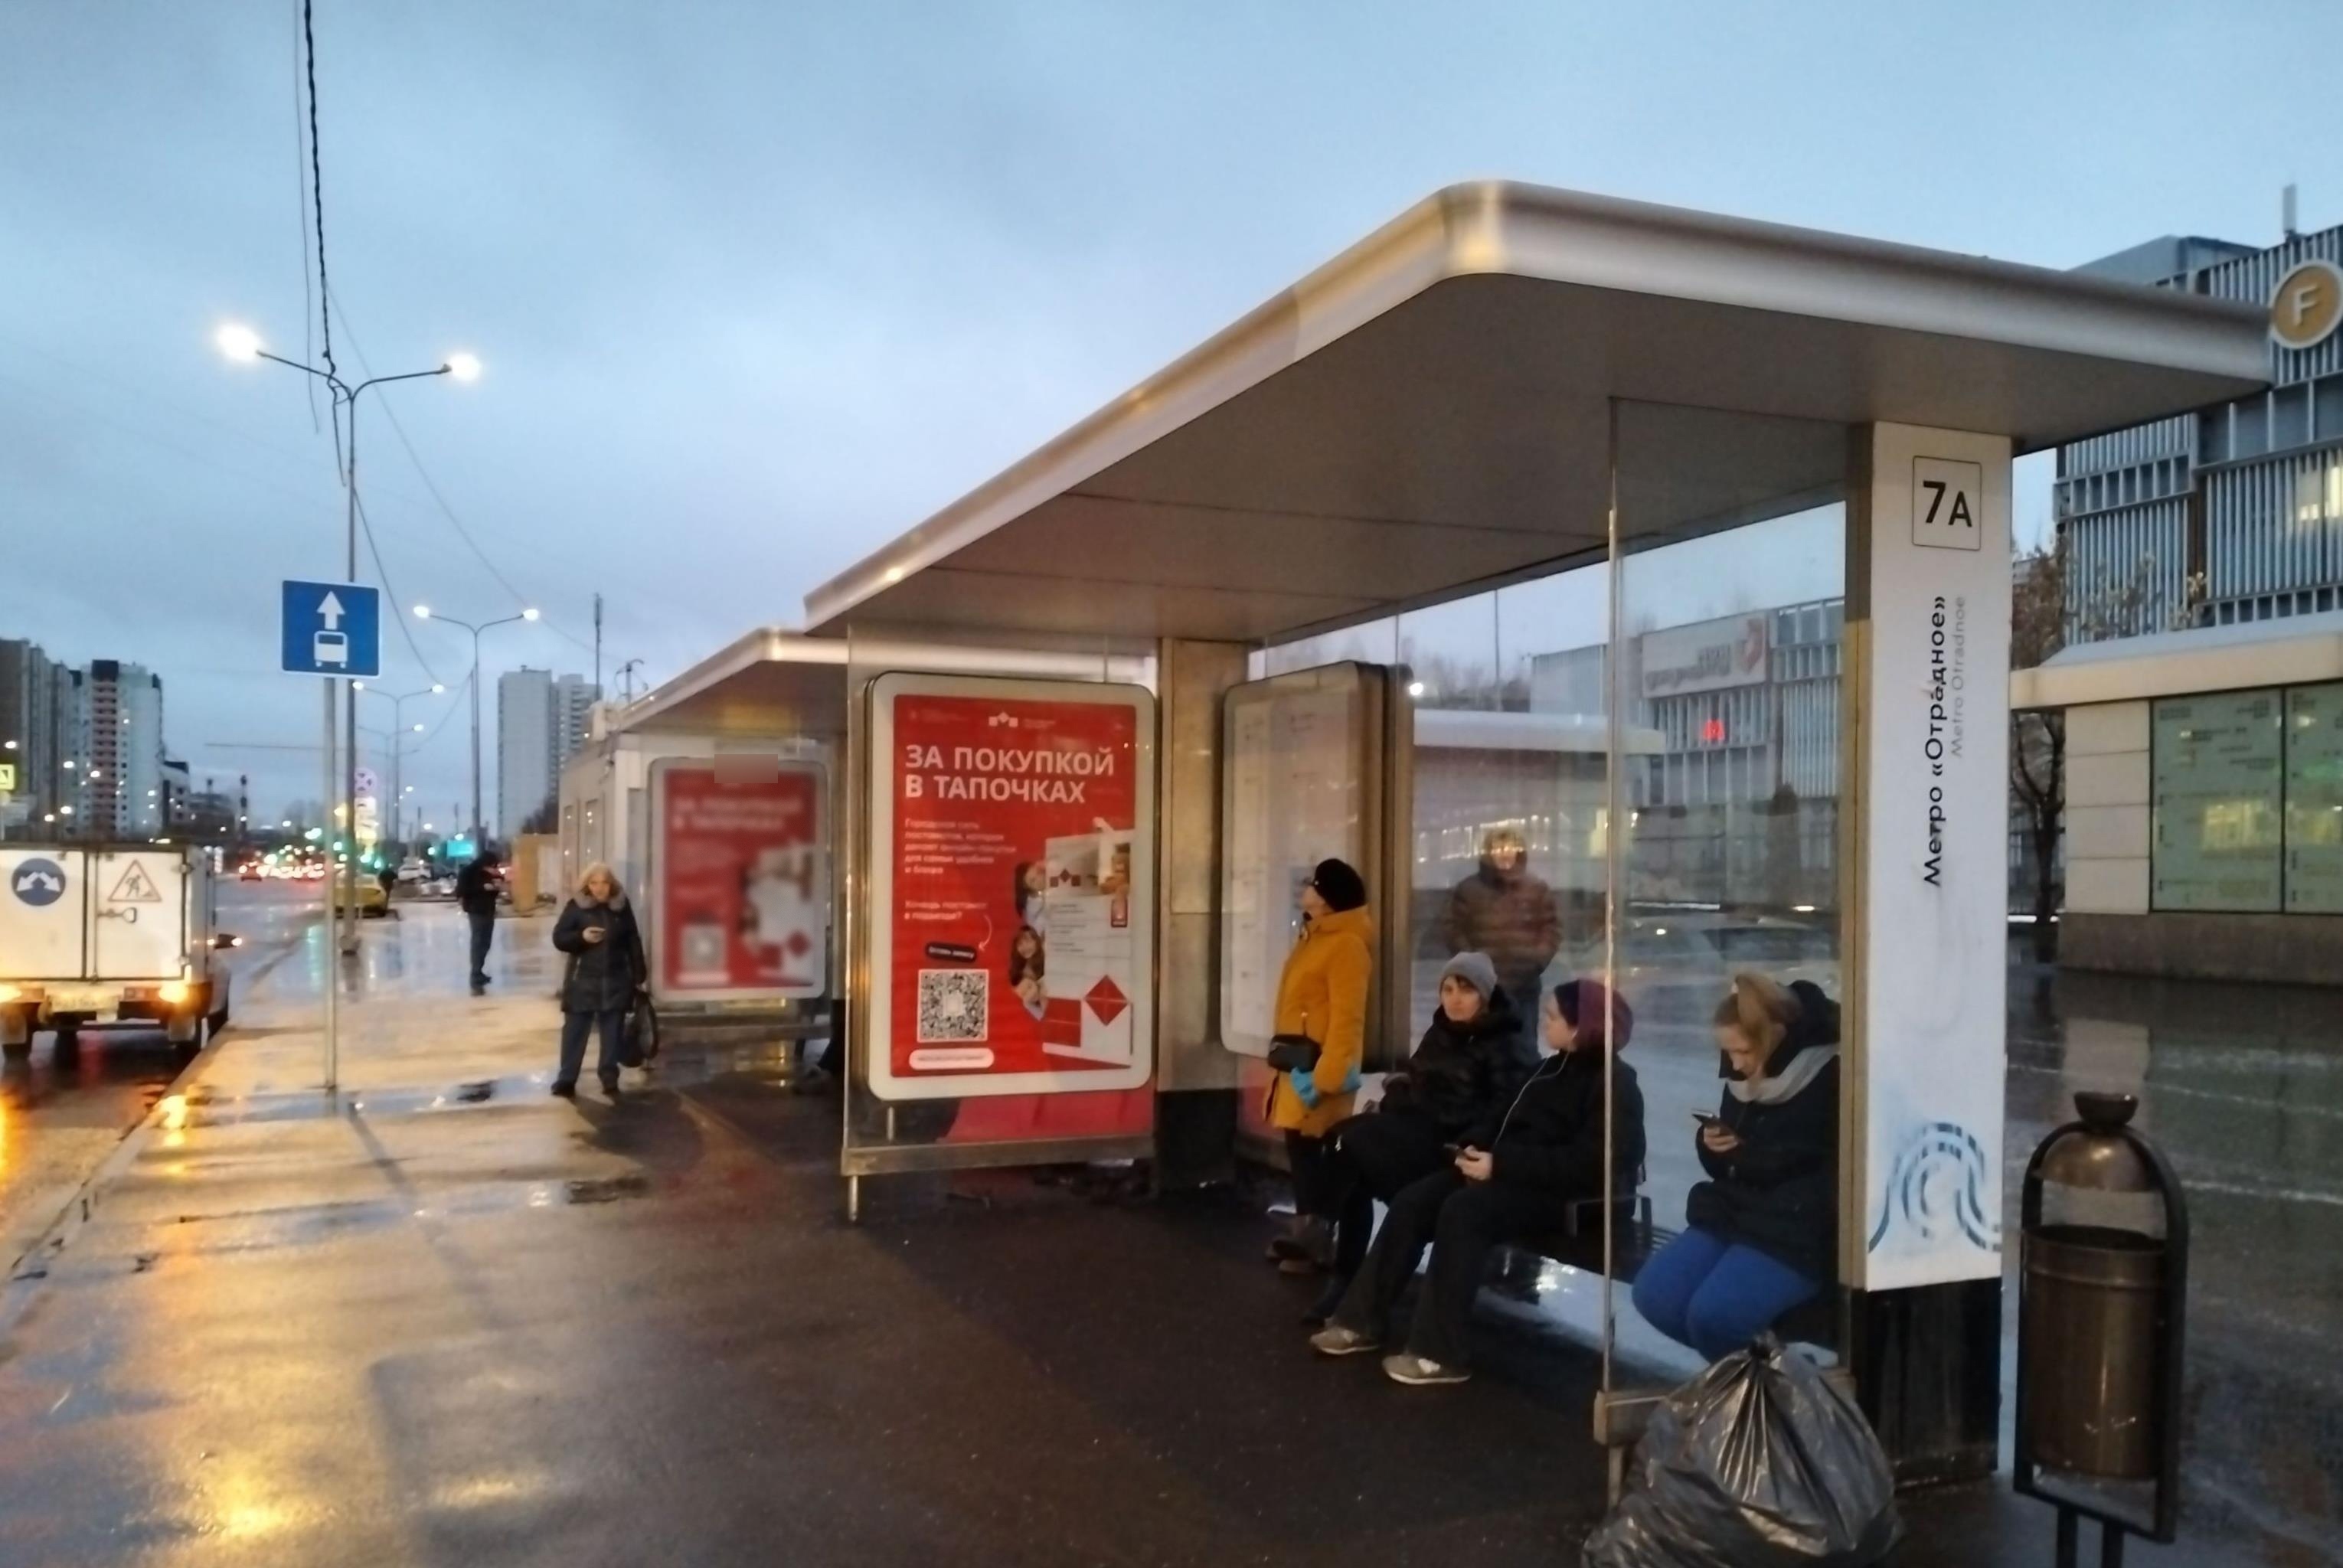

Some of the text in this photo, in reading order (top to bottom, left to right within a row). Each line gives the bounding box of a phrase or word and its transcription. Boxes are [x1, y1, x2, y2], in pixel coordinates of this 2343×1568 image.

[2293, 283, 2320, 326] F
[1923, 479, 1972, 528] 7А
[1951, 596, 1966, 758] Metro Otradnoe
[906, 745, 1114, 776] ЗА ПОКУПКОЙ
[1923, 596, 1947, 887] Метро «Отрадное»
[905, 774, 1086, 803] В ТАПОЧКАХ
